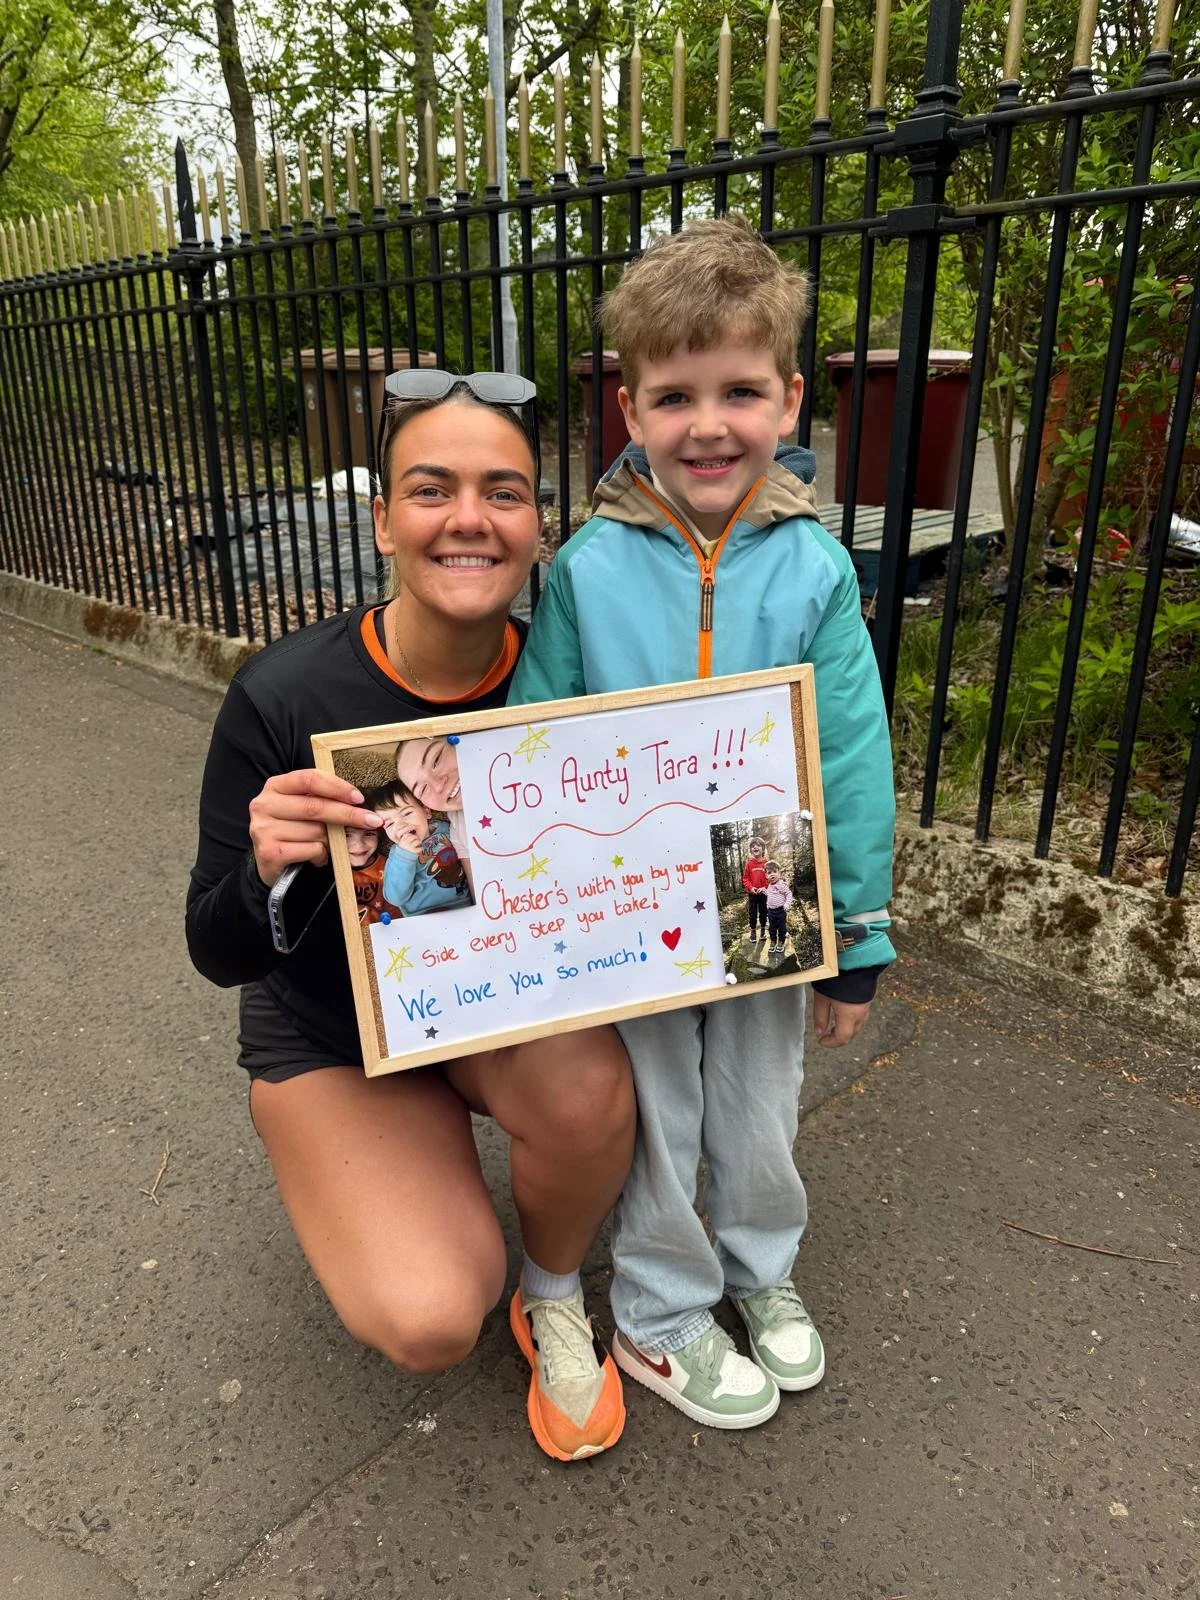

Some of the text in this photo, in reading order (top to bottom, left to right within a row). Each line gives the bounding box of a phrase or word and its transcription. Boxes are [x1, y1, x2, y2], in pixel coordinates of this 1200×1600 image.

[489, 752, 542, 813] Go
[561, 756, 630, 804] Aunty
[641, 740, 698, 784] Tara
[470, 931, 517, 953] every
[577, 911, 605, 933] you
[614, 886, 659, 916] take!
[481, 861, 703, 920] Chester's with you by your
[398, 989, 442, 1021] We
[455, 982, 497, 1006] love
[587, 931, 647, 973] much!
